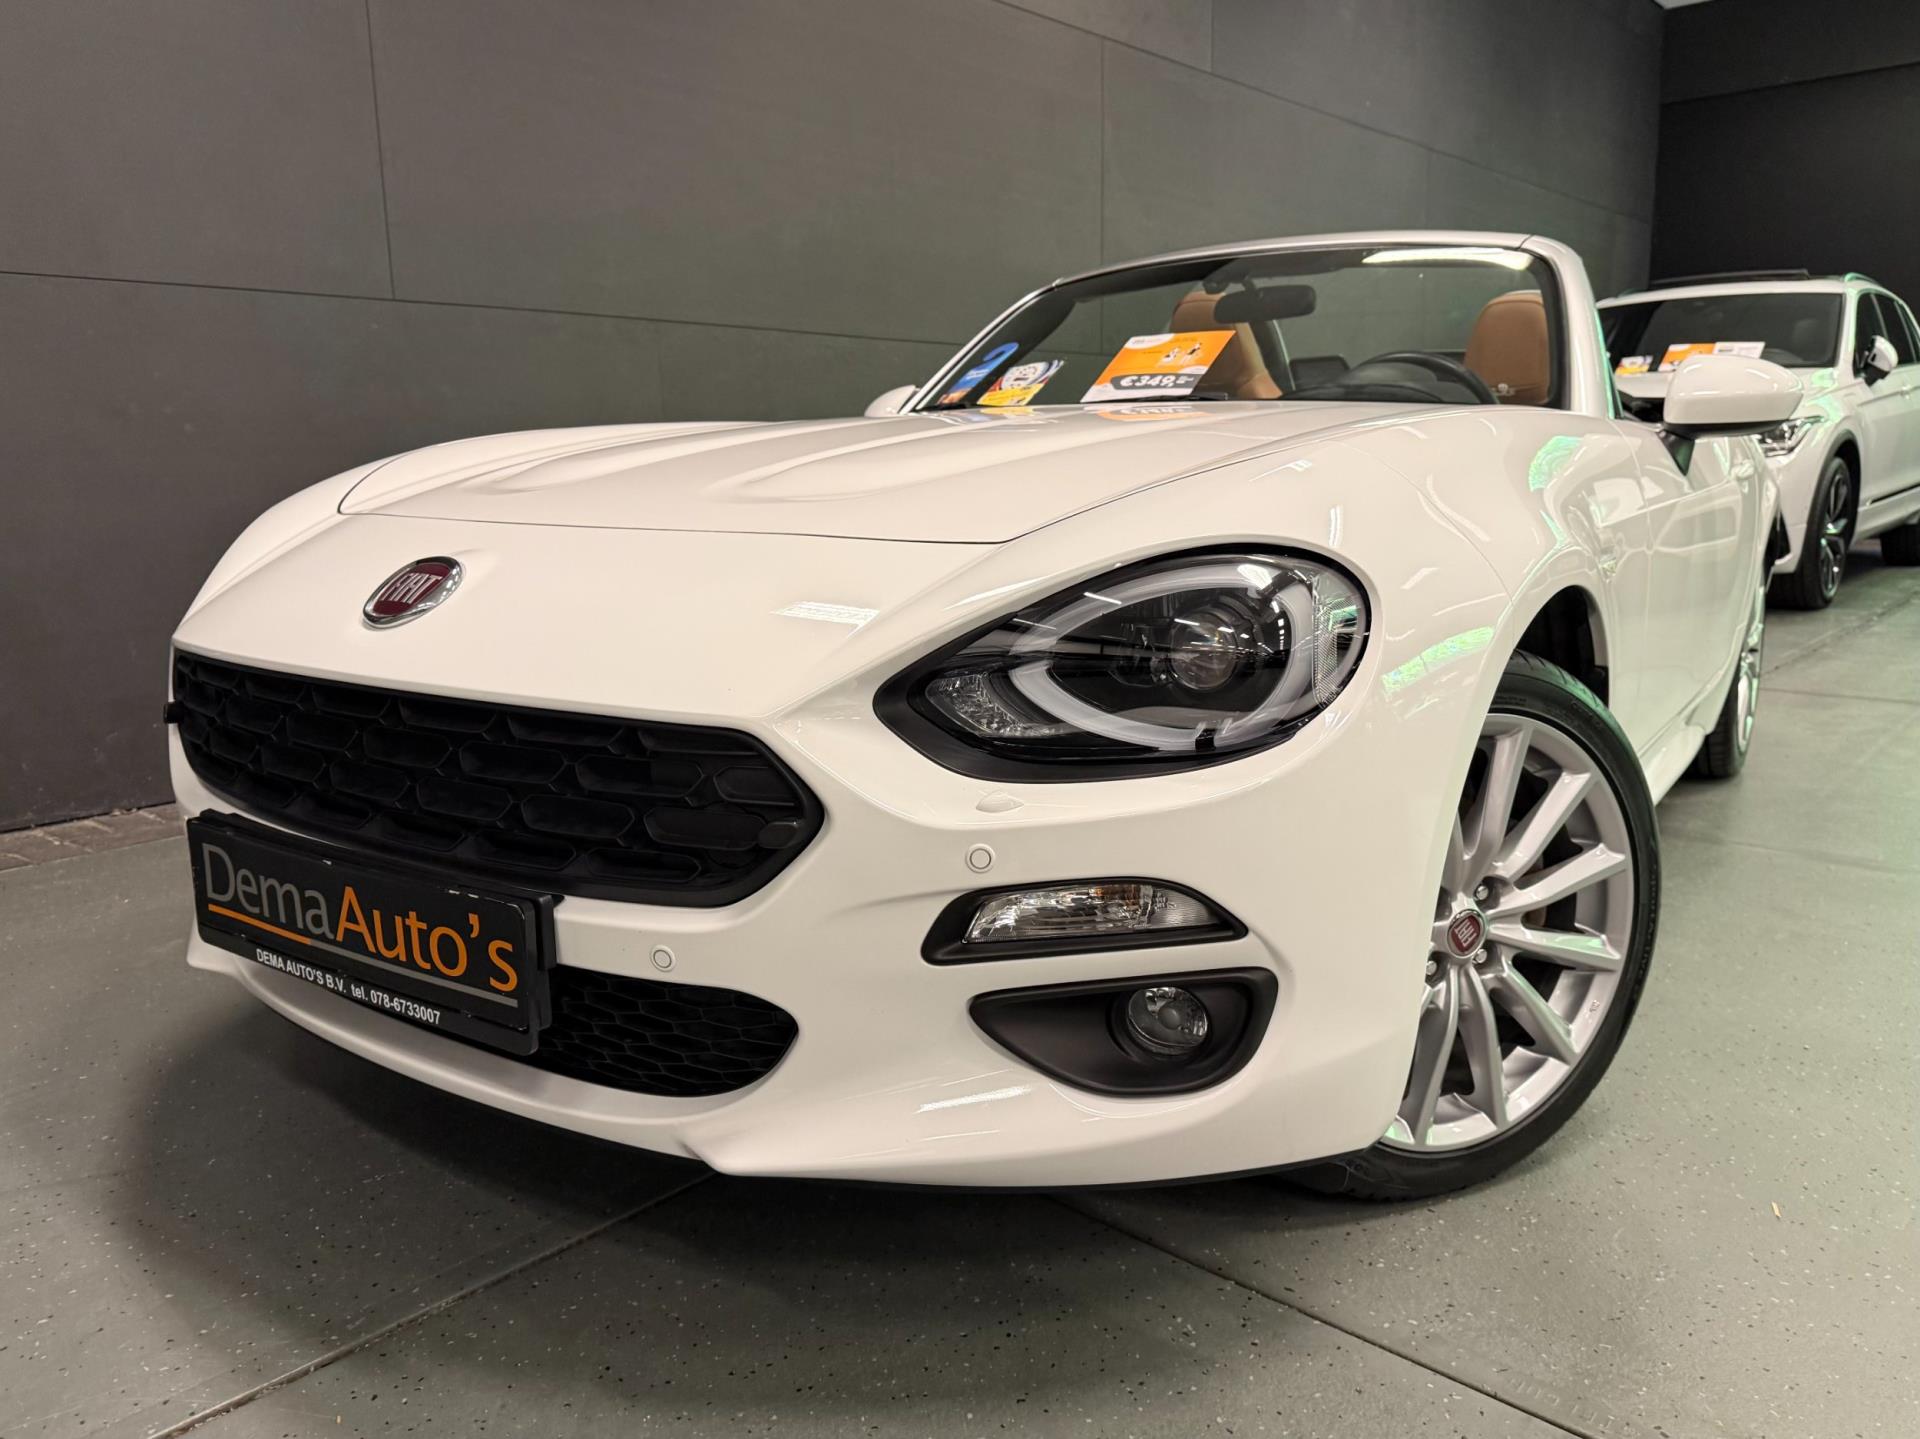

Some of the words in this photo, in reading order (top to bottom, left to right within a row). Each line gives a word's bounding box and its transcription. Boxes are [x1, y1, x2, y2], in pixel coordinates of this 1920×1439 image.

[381, 572, 443, 604] FIAT
[1453, 918, 1478, 948] FIAT
[256, 948, 285, 971] DEMA
[286, 959, 324, 985] AUTO'S
[325, 974, 347, 993] B.V.
[351, 983, 368, 1001] tel.
[370, 990, 441, 1025] 078-6733007
